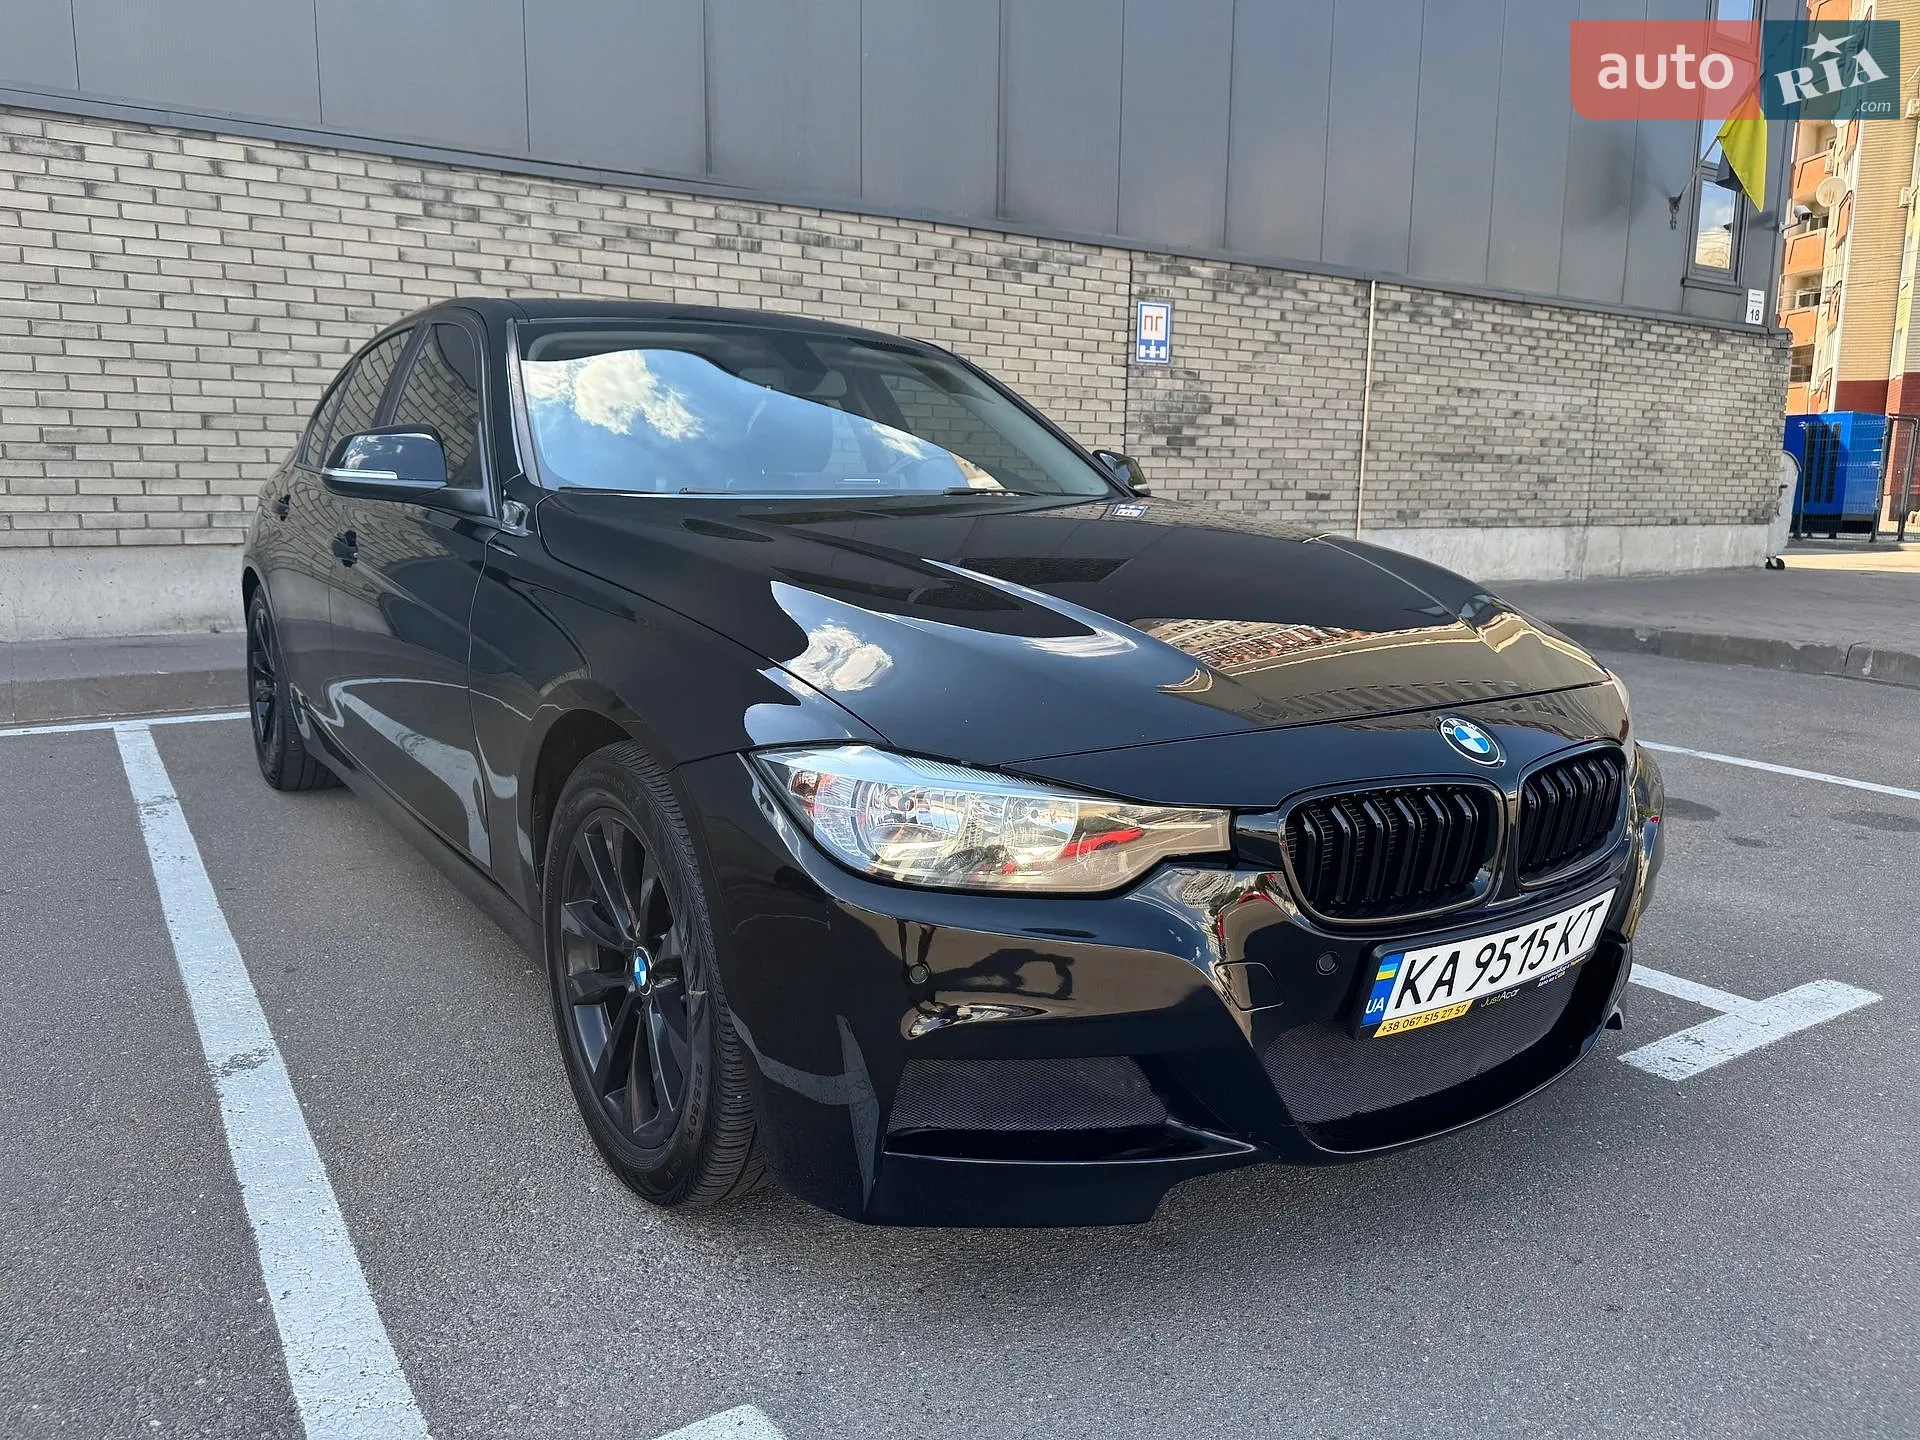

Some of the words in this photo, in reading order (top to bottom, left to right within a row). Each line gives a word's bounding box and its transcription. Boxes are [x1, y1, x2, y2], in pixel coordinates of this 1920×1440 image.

[1143, 315, 1164, 332] ПГ
[1749, 308, 1761, 322] 18
[1394, 950, 1460, 1010] KA
[1465, 921, 1558, 992] 9515
[1552, 900, 1605, 961] KT
[1365, 996, 1385, 1014] UA
[1382, 1022, 1400, 1033] +38
[1402, 1017, 1422, 1028] 067
[1424, 1012, 1440, 1023] 515
[1441, 1008, 1454, 1019] 27
[1455, 1004, 1467, 1015] 57
